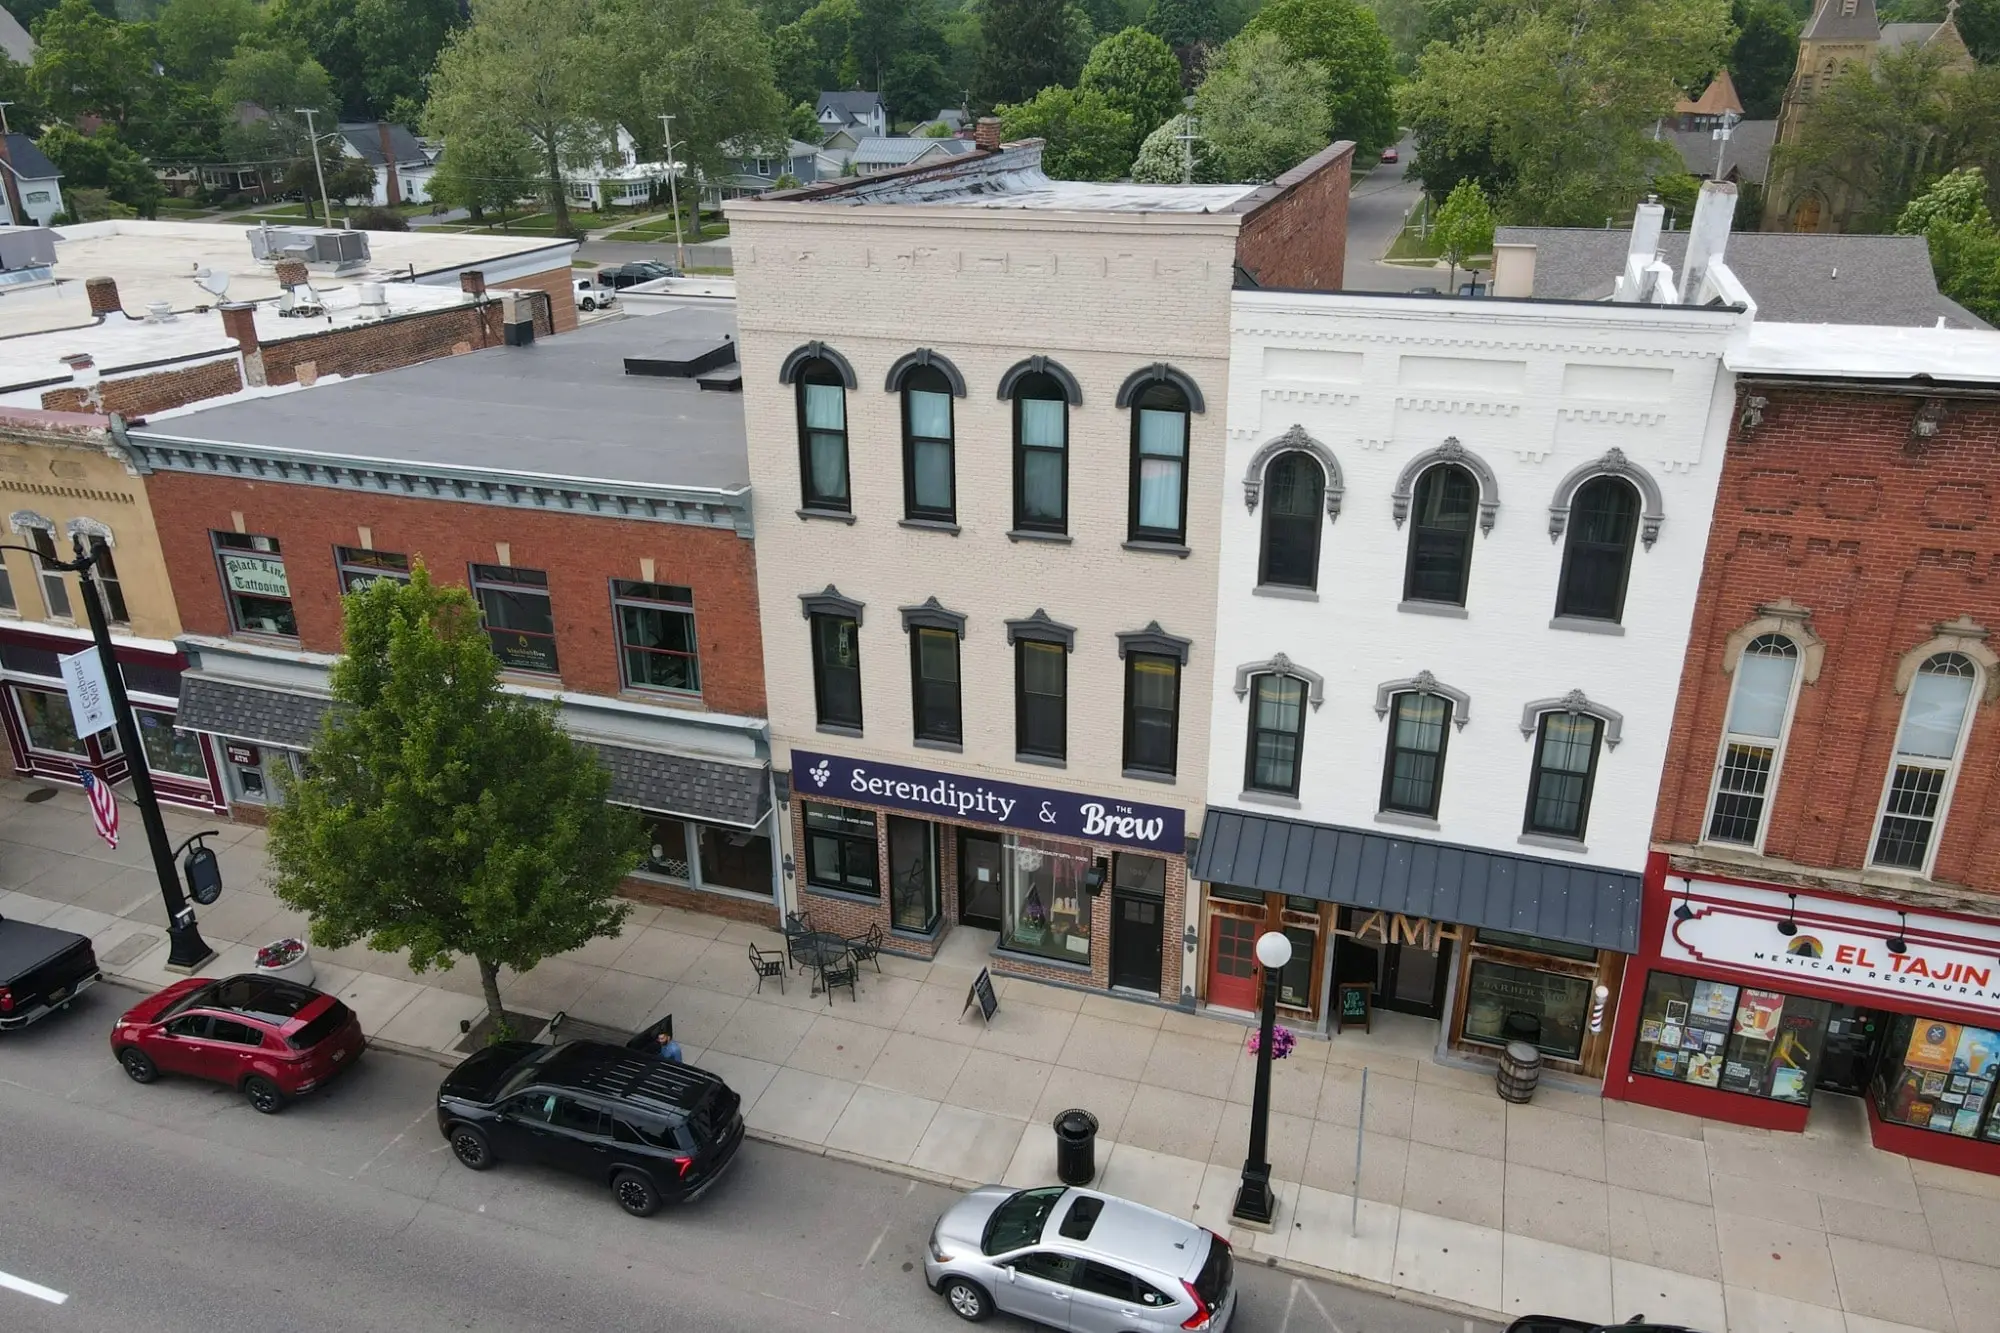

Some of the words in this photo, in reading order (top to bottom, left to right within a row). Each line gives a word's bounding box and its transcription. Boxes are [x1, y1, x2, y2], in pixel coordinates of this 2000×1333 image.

[227, 560, 258, 573] Black
[234, 576, 288, 596] Tattooing
[74, 660, 92, 709] Celebrate
[87, 680, 100, 705] Well
[850, 768, 1016, 821] Serendipity
[1038, 801, 1057, 824] &
[1116, 805, 1133, 814] THE
[1080, 803, 1164, 841] Brew
[1753, 951, 1852, 974] MEXICAN
[1868, 971, 2000, 999] RESTAURAN
[1834, 944, 1875, 968] EL
[1887, 952, 1991, 987] TAJIN
[1482, 981, 1537, 996] BARBER
